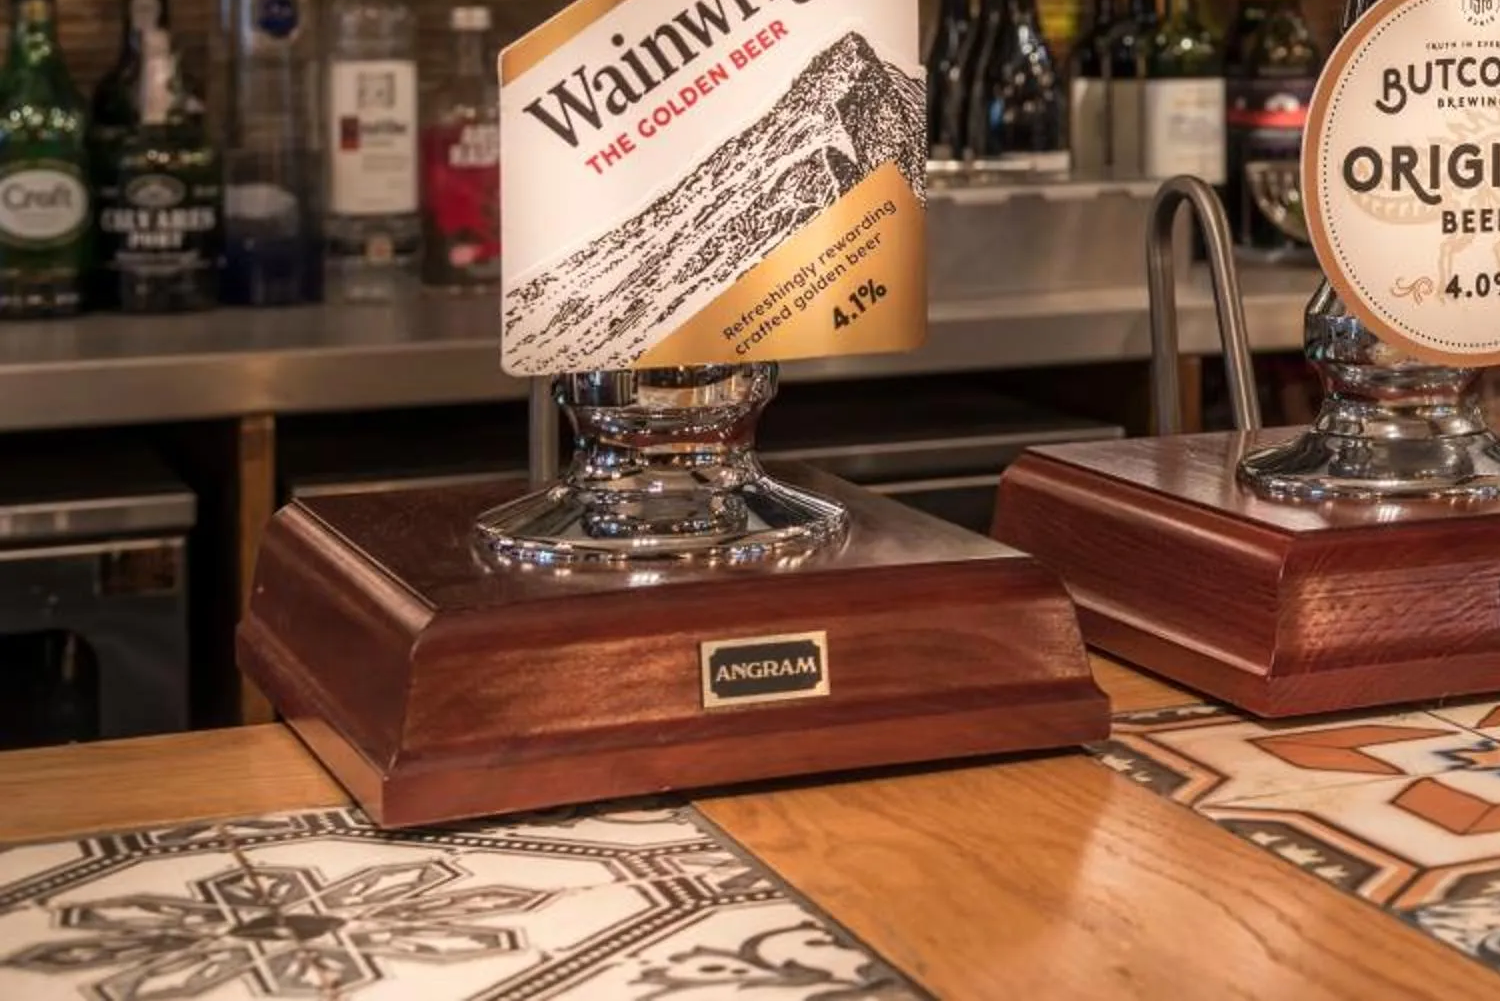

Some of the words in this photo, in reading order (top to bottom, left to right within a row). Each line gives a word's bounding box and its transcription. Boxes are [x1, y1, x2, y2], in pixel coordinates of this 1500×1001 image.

[584, 132, 637, 175] THE
[637, 62, 730, 138] GOLDEN
[729, 20, 789, 70] BEER
[723, 262, 817, 340] Refreshingly
[817, 200, 897, 266] rewarding
[735, 305, 793, 355] crafted
[794, 262, 848, 311] golden
[845, 232, 882, 265] beer
[832, 278, 887, 331] 4.1%
[716, 656, 817, 682] ANGRAM
